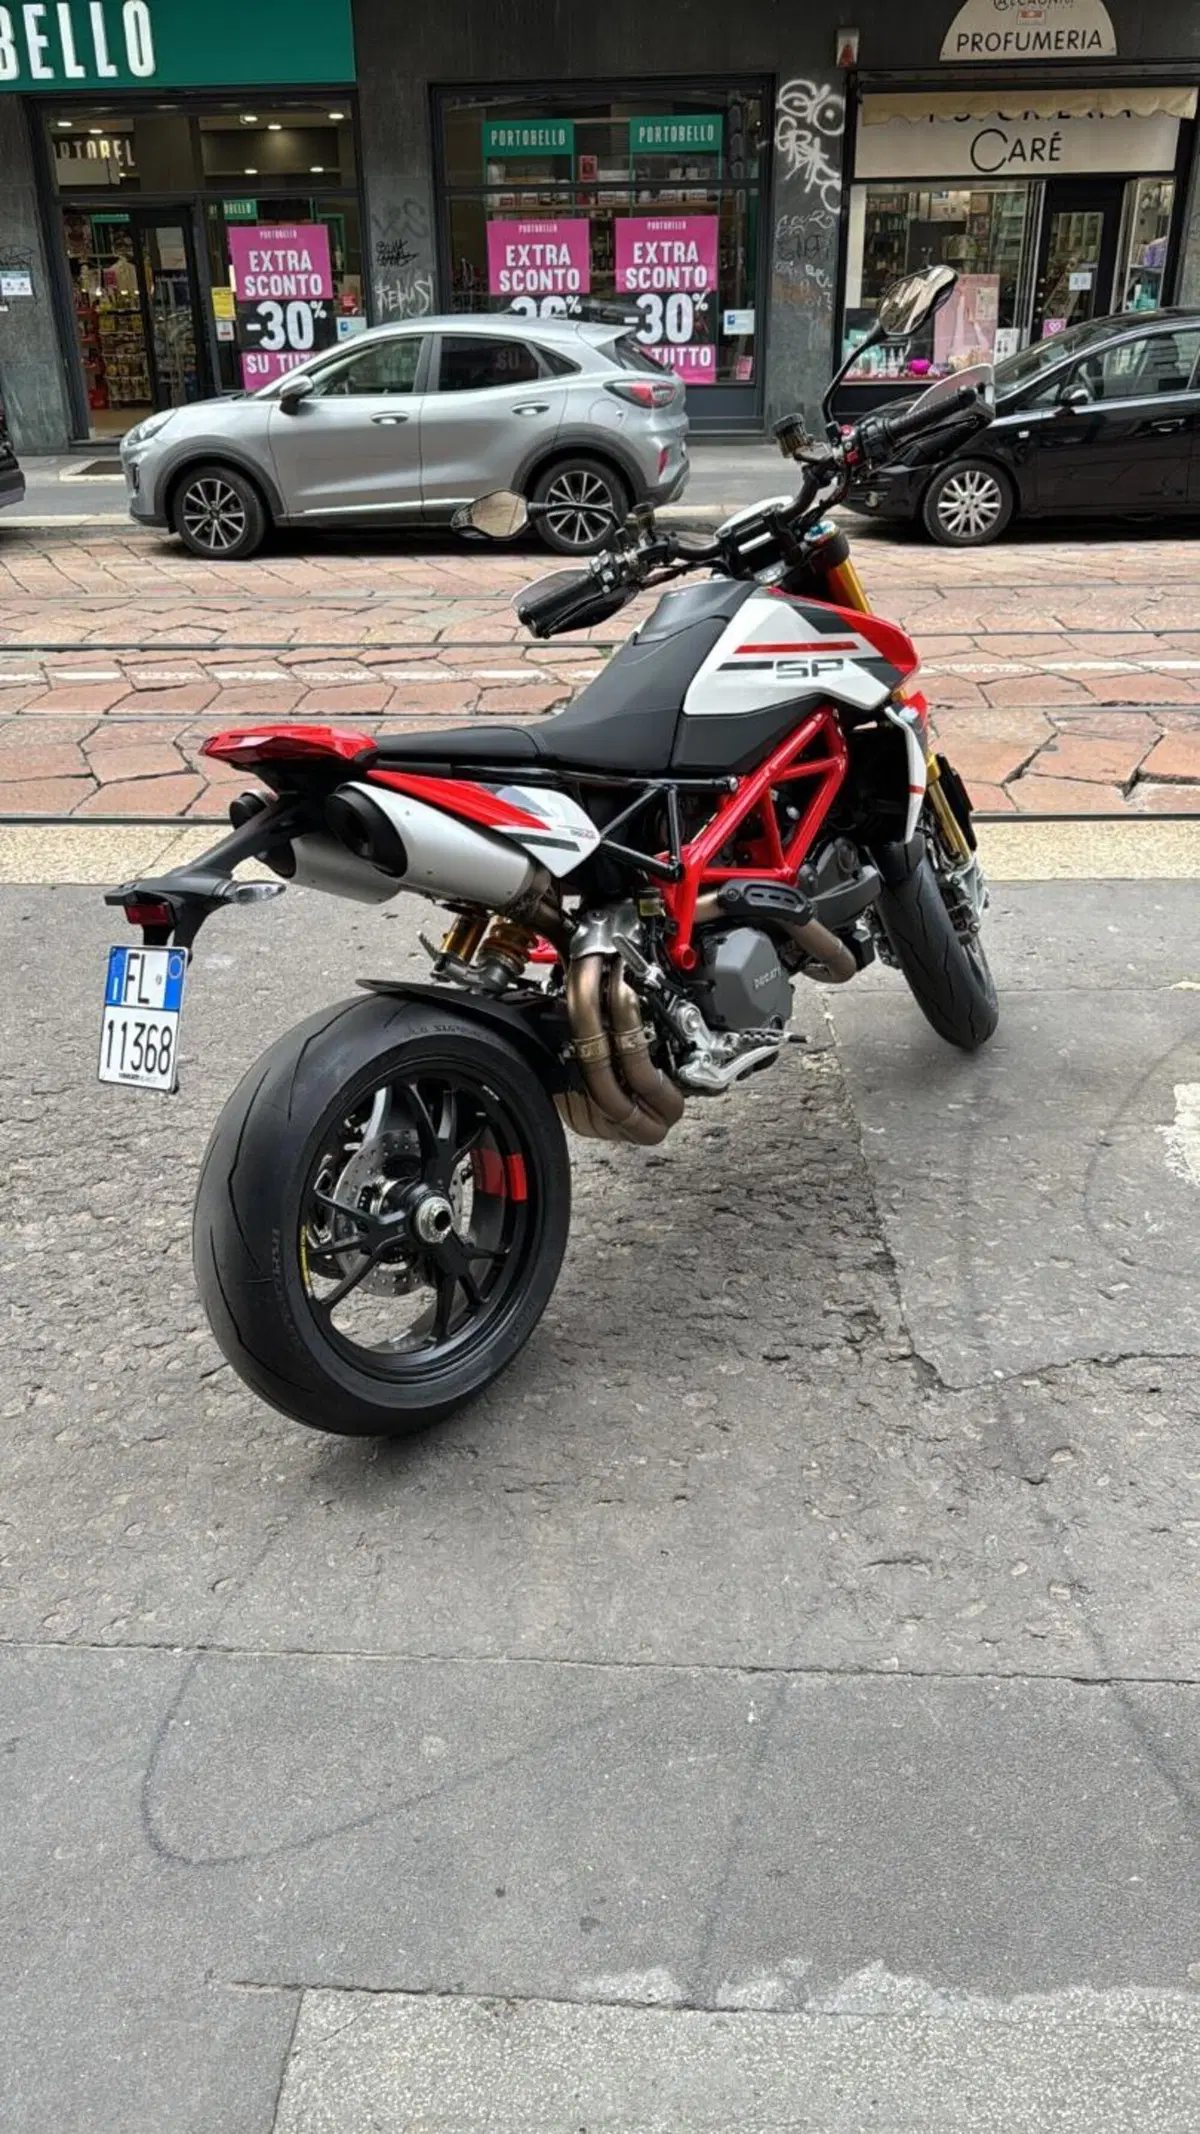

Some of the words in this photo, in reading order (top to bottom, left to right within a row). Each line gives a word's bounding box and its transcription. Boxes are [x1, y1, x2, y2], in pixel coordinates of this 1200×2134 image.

[956, 29, 1103, 53] PROFUMERIA
[491, 128, 566, 146] PORTOBELLO
[638, 124, 715, 143] PORTOBELLO
[249, 249, 313, 273] EXTRA
[505, 243, 572, 267] EXTRA
[633, 241, 699, 265] EXTRA
[244, 273, 323, 297] SCONTO
[499, 267, 581, 292] SCONTO
[625, 265, 708, 290] SCONTO
[246, 300, 328, 351] -30%
[246, 353, 270, 374] SU
[776, 658, 844, 679] SP
[124, 953, 150, 1004] FL
[107, 1019, 173, 1075] 11368
